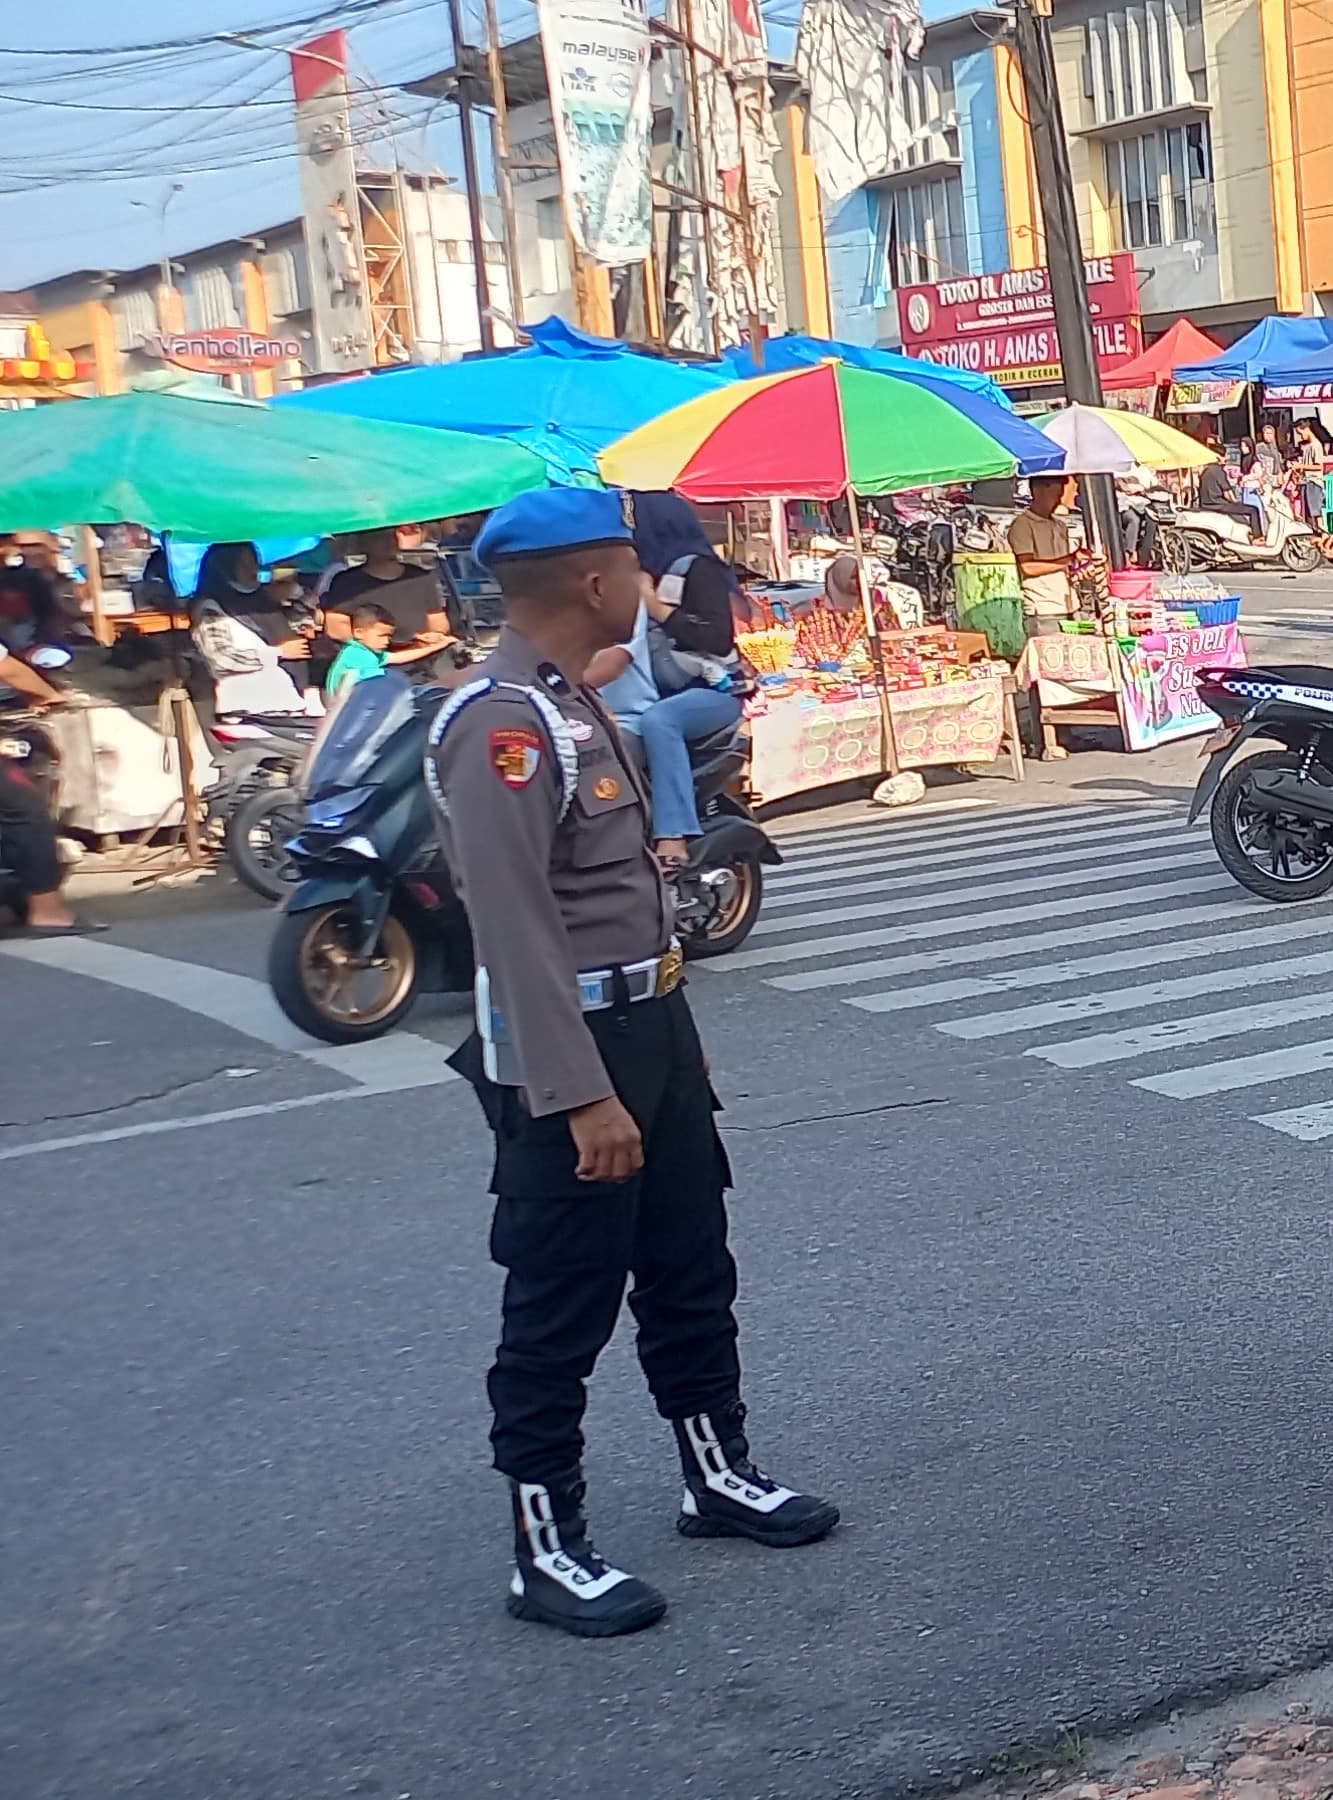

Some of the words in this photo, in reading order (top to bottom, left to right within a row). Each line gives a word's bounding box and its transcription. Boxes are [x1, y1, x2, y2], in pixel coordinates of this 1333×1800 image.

[937, 279, 980, 306] TOKO
[1001, 270, 1044, 297] ANAS
[940, 340, 980, 370] TOKO
[985, 338, 1000, 367] H.
[1004, 332, 1049, 365] ANAS
[1028, 368, 1059, 380] ECERAN
[1165, 633, 1189, 660] Es
